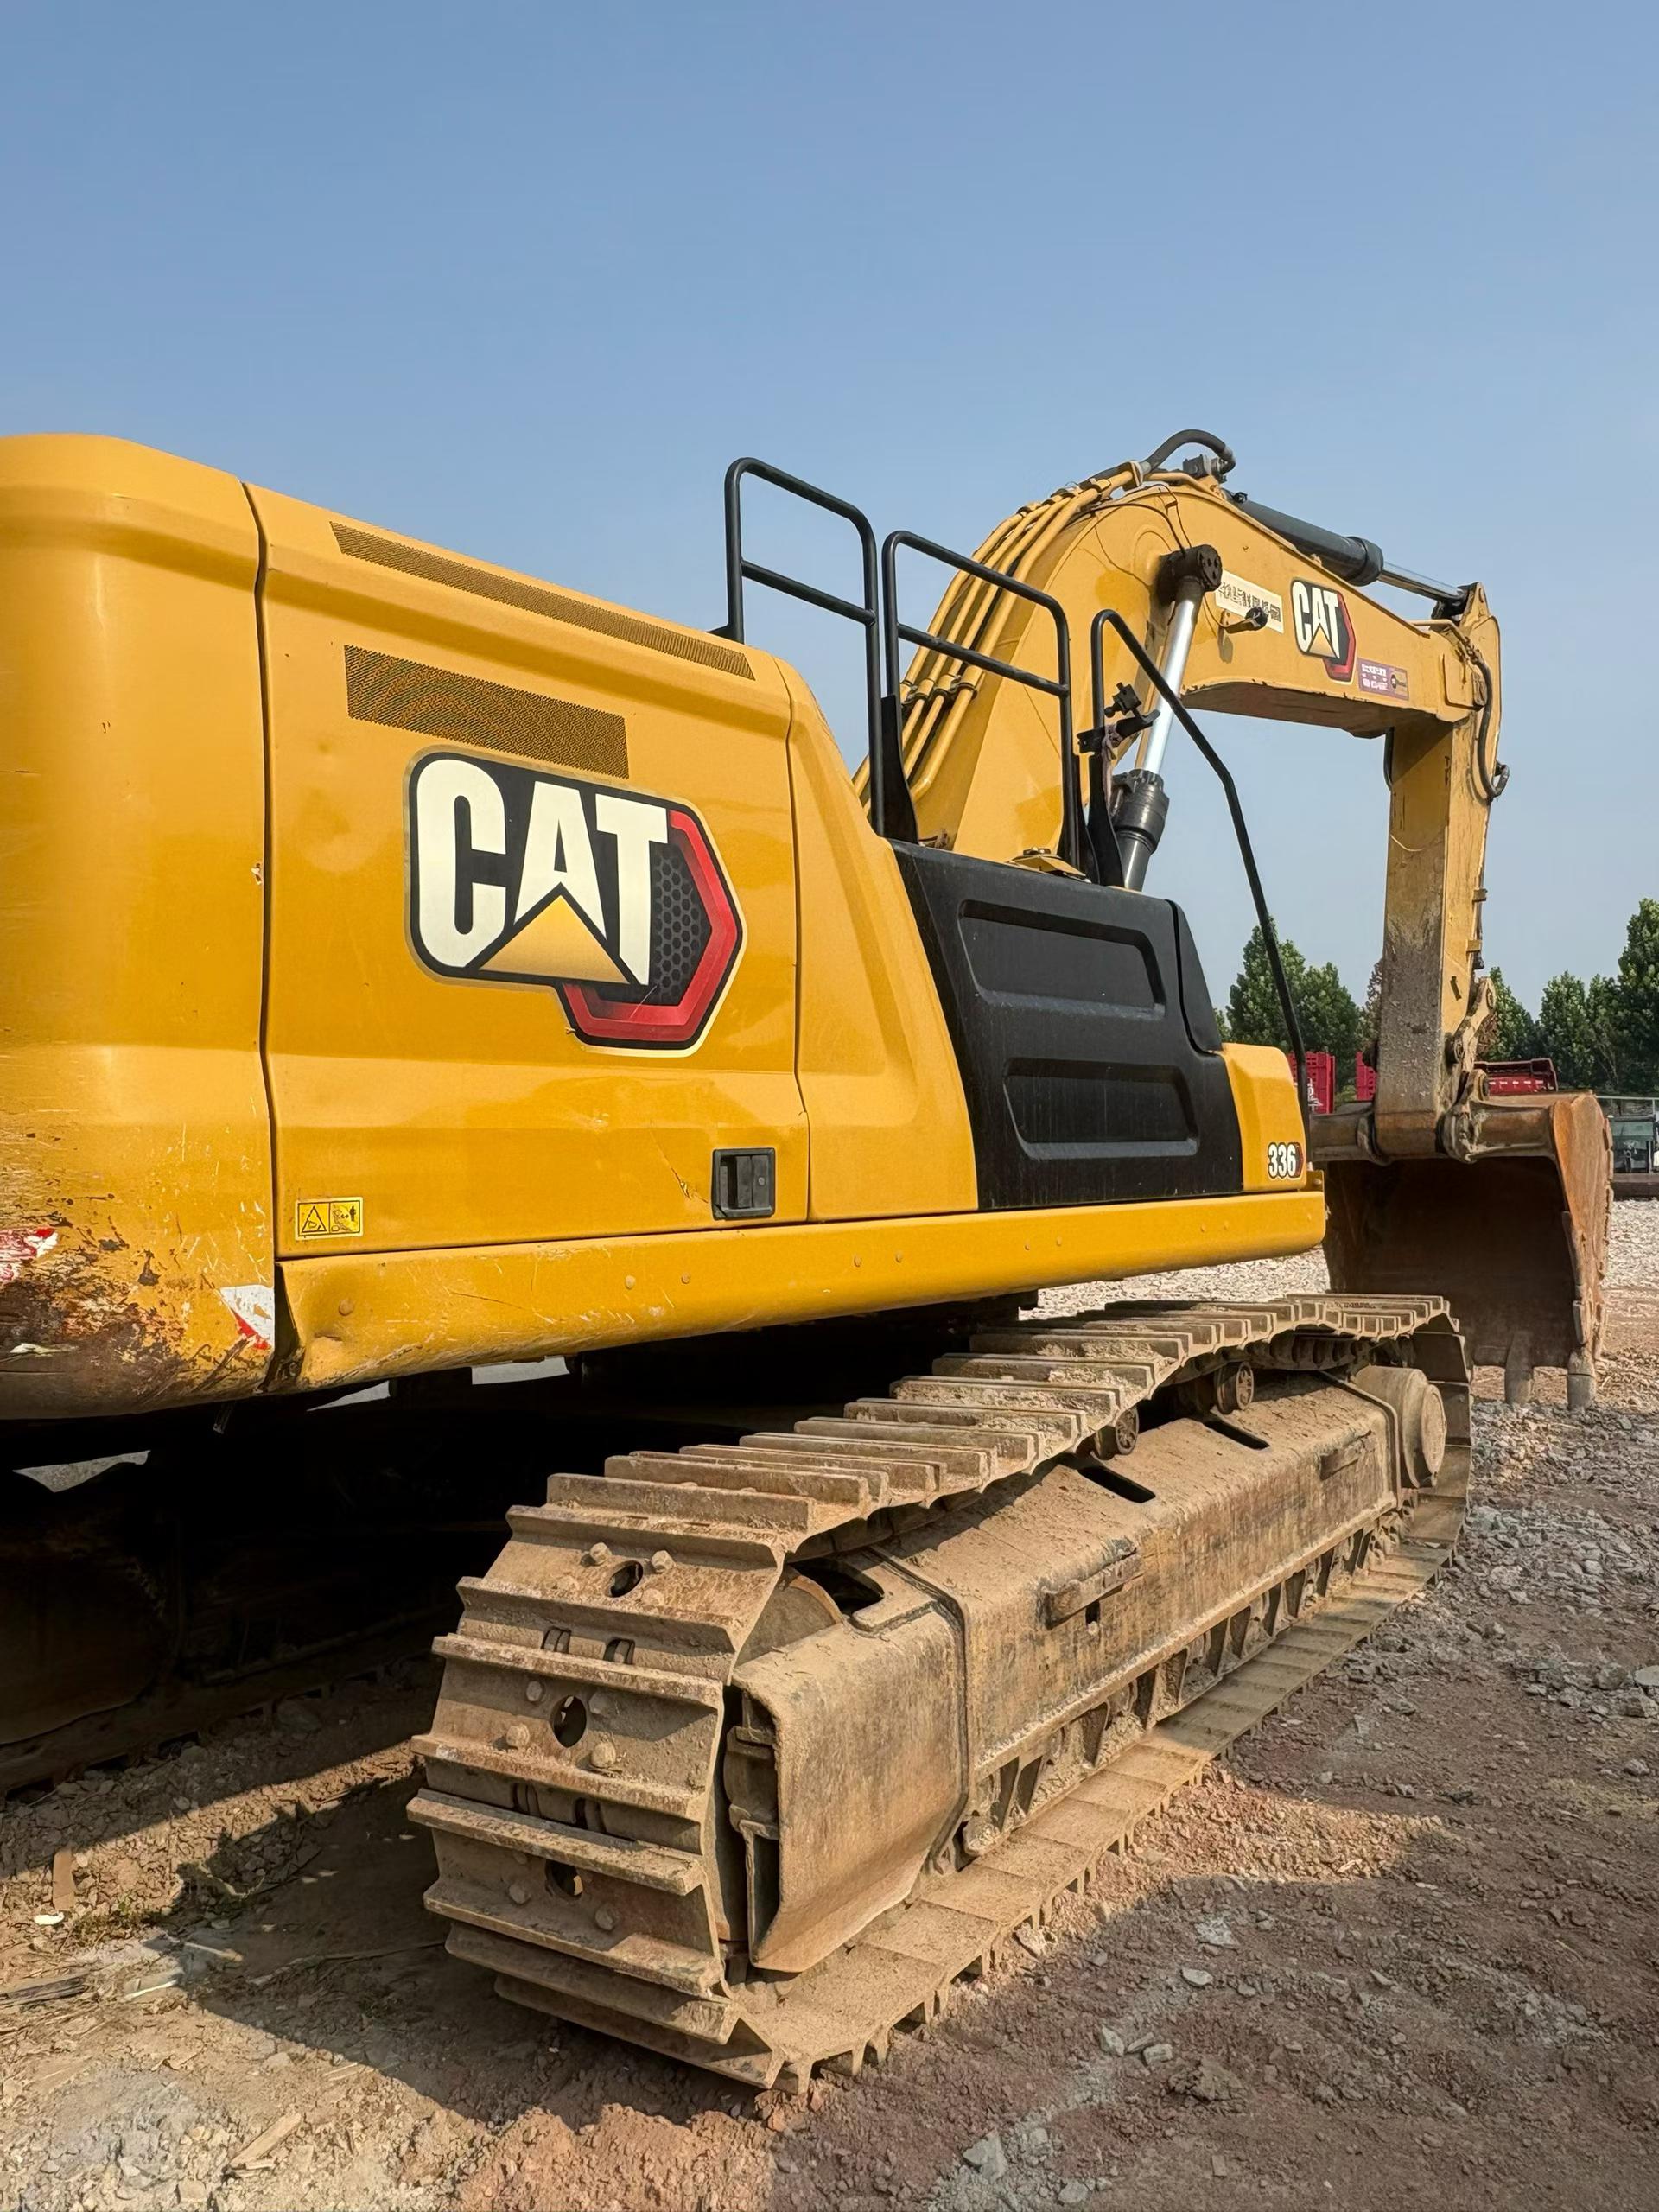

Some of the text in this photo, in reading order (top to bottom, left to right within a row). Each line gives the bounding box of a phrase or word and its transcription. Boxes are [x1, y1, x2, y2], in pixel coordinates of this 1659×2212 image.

[1292, 581, 1338, 658] CAT
[416, 759, 668, 985] CAT
[1268, 1143, 1296, 1177] 336
